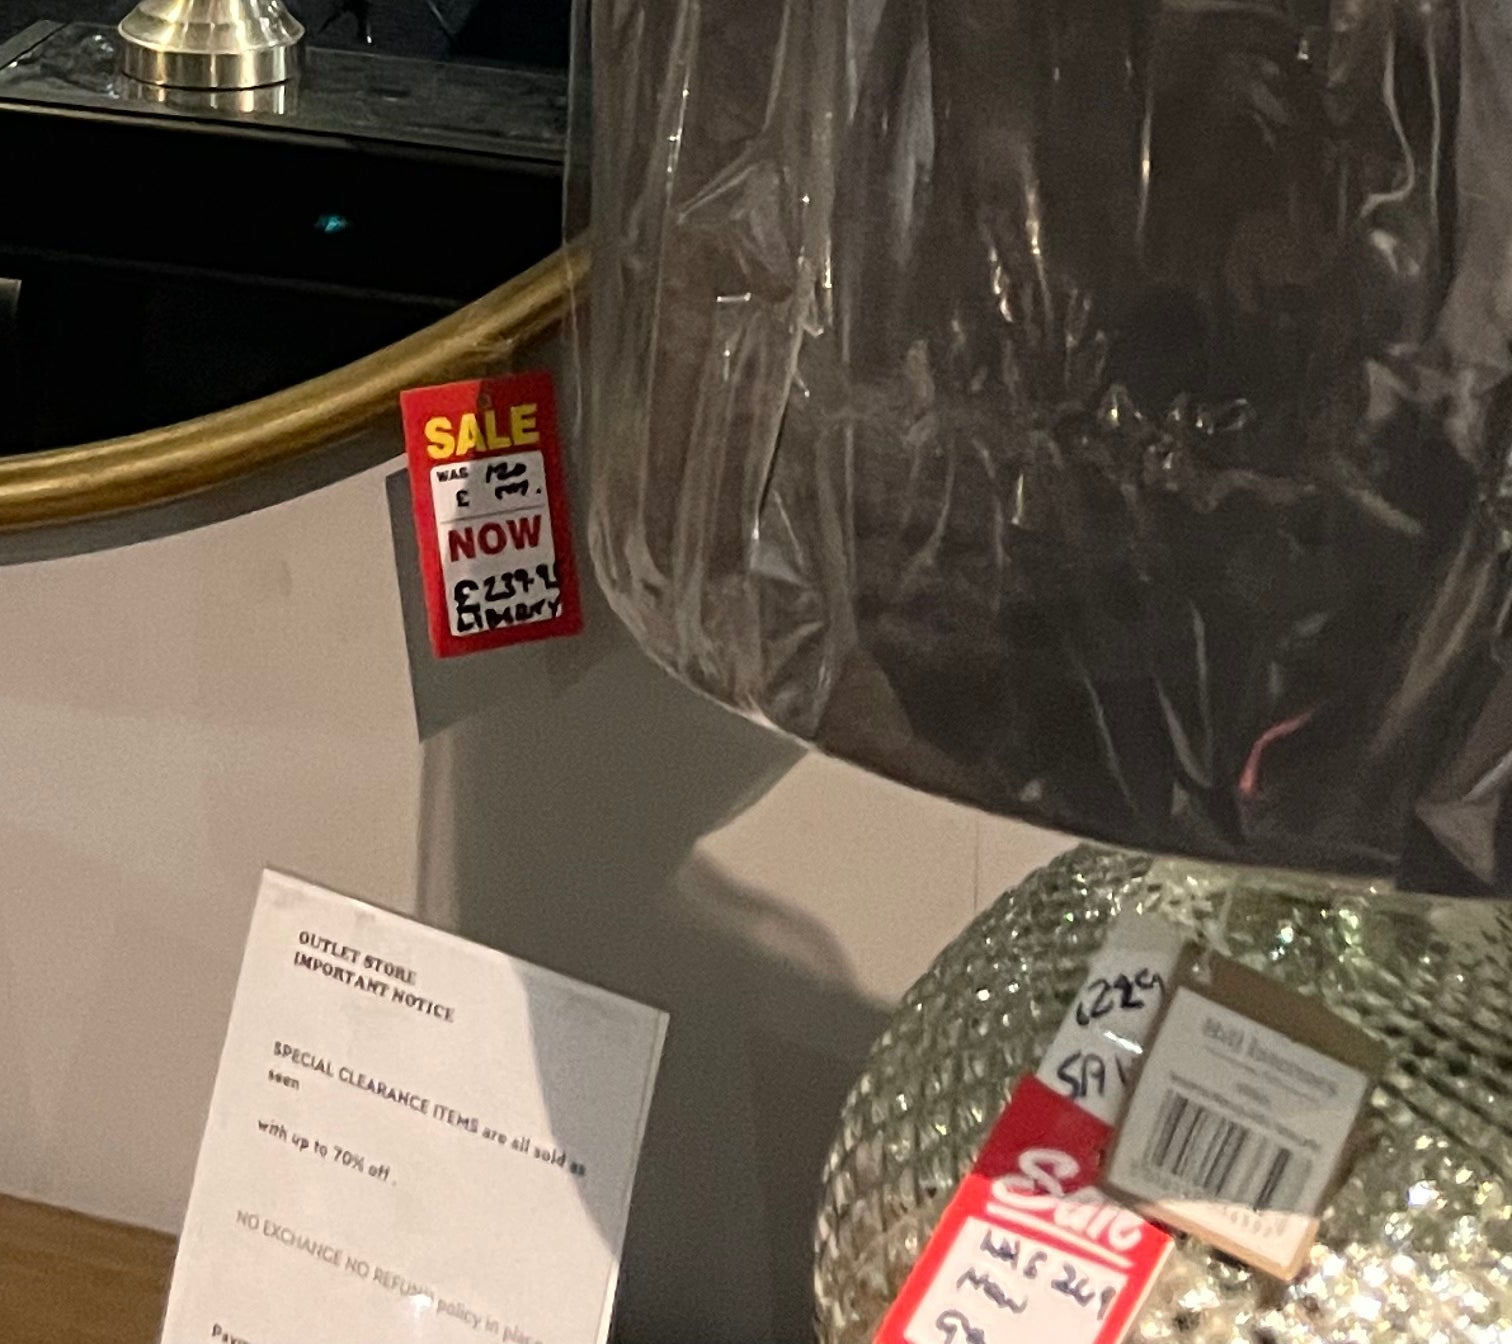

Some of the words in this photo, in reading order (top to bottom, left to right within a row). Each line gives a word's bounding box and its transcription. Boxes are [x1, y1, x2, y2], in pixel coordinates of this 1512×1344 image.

[424, 402, 541, 460] SALE
[437, 466, 469, 482] WAS
[447, 514, 543, 564] NOW
[293, 951, 390, 998] IMPORTANT
[391, 986, 457, 1023] NOTICE
[298, 930, 361, 964] OUTLET
[362, 954, 419, 986] STORE
[268, 1068, 301, 1092] seen
[272, 1040, 335, 1078] SPECIAL
[337, 1065, 430, 1116] CLEARANCE
[432, 1102, 480, 1134] ITEMS
[482, 1125, 508, 1146] are
[511, 1135, 531, 1155] all
[533, 1143, 567, 1169] sold
[257, 1117, 288, 1141] with
[292, 1133, 310, 1153] up
[313, 1139, 329, 1158] to
[332, 1144, 365, 1173] 70%
[367, 1160, 392, 1182] off
[991, 1147, 1144, 1252] Sale
[236, 1209, 260, 1233] NO
[263, 1218, 341, 1267] EXCHANGE
[345, 1255, 370, 1280] NO
[435, 1297, 482, 1330] policy
[485, 1314, 501, 1335] in
